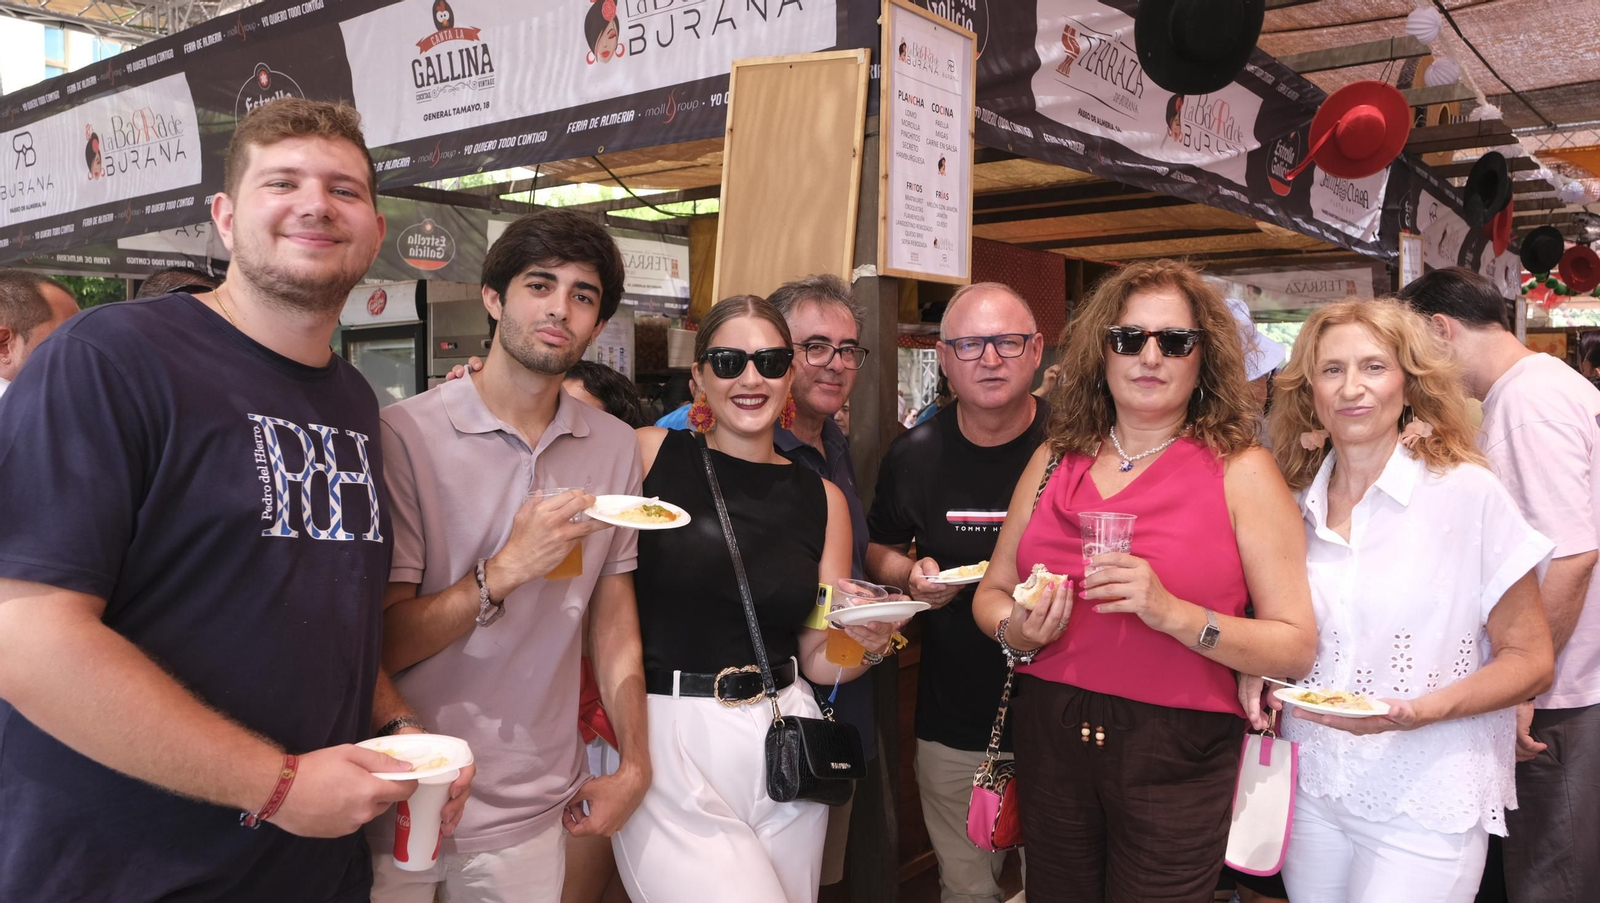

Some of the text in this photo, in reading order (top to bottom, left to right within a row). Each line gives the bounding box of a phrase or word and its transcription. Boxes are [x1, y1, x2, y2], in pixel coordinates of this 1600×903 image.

[196, 38, 202, 50] DE
[261, 16, 269, 27] YO
[269, 10, 287, 25] QUIERO
[288, 6, 301, 19] TODO
[430, 29, 464, 46] CANTA LA
[411, 43, 494, 88] GALLINA
[907, 55, 939, 75] BURANA
[1078, 32, 1144, 99] TERRAZA
[478, 78, 495, 88] VINTAGE
[898, 90, 925, 108] PLANCHA
[423, 101, 490, 121] GENERAL TAMAYO, 18
[566, 119, 588, 134] FERIA
[589, 117, 599, 129] DE
[600, 110, 635, 127] ALMERIA
[710, 93, 722, 107] YO
[905, 109, 917, 119] LOMO
[931, 103, 954, 118] COCINA
[1078, 108, 1090, 120] PASEO
[1091, 114, 1096, 123] DE
[901, 119, 920, 131] MORCILLA
[935, 120, 949, 130] PAELLA
[901, 130, 920, 142] PINCHITOS
[935, 130, 949, 140] MIGAS
[376, 161, 383, 172] DE
[384, 156, 410, 171] ALMERIA
[464, 145, 473, 156] YO
[473, 140, 497, 155] QUIERO
[498, 136, 516, 150] TODO
[517, 130, 547, 147] CONTIGO
[902, 141, 919, 152] SECRETO
[926, 138, 938, 148] CARNE
[946, 143, 958, 153] SALSA
[1274, 139, 1295, 164] Estrella
[105, 138, 187, 176] BURANA
[896, 150, 925, 165] HAMBURGUESA
[0, 174, 54, 200] BURANA
[906, 182, 923, 193] FRITOS
[145, 205, 150, 214] YO
[177, 196, 194, 208] CONTIGO
[253, 424, 273, 521] Pedro del Hierro
